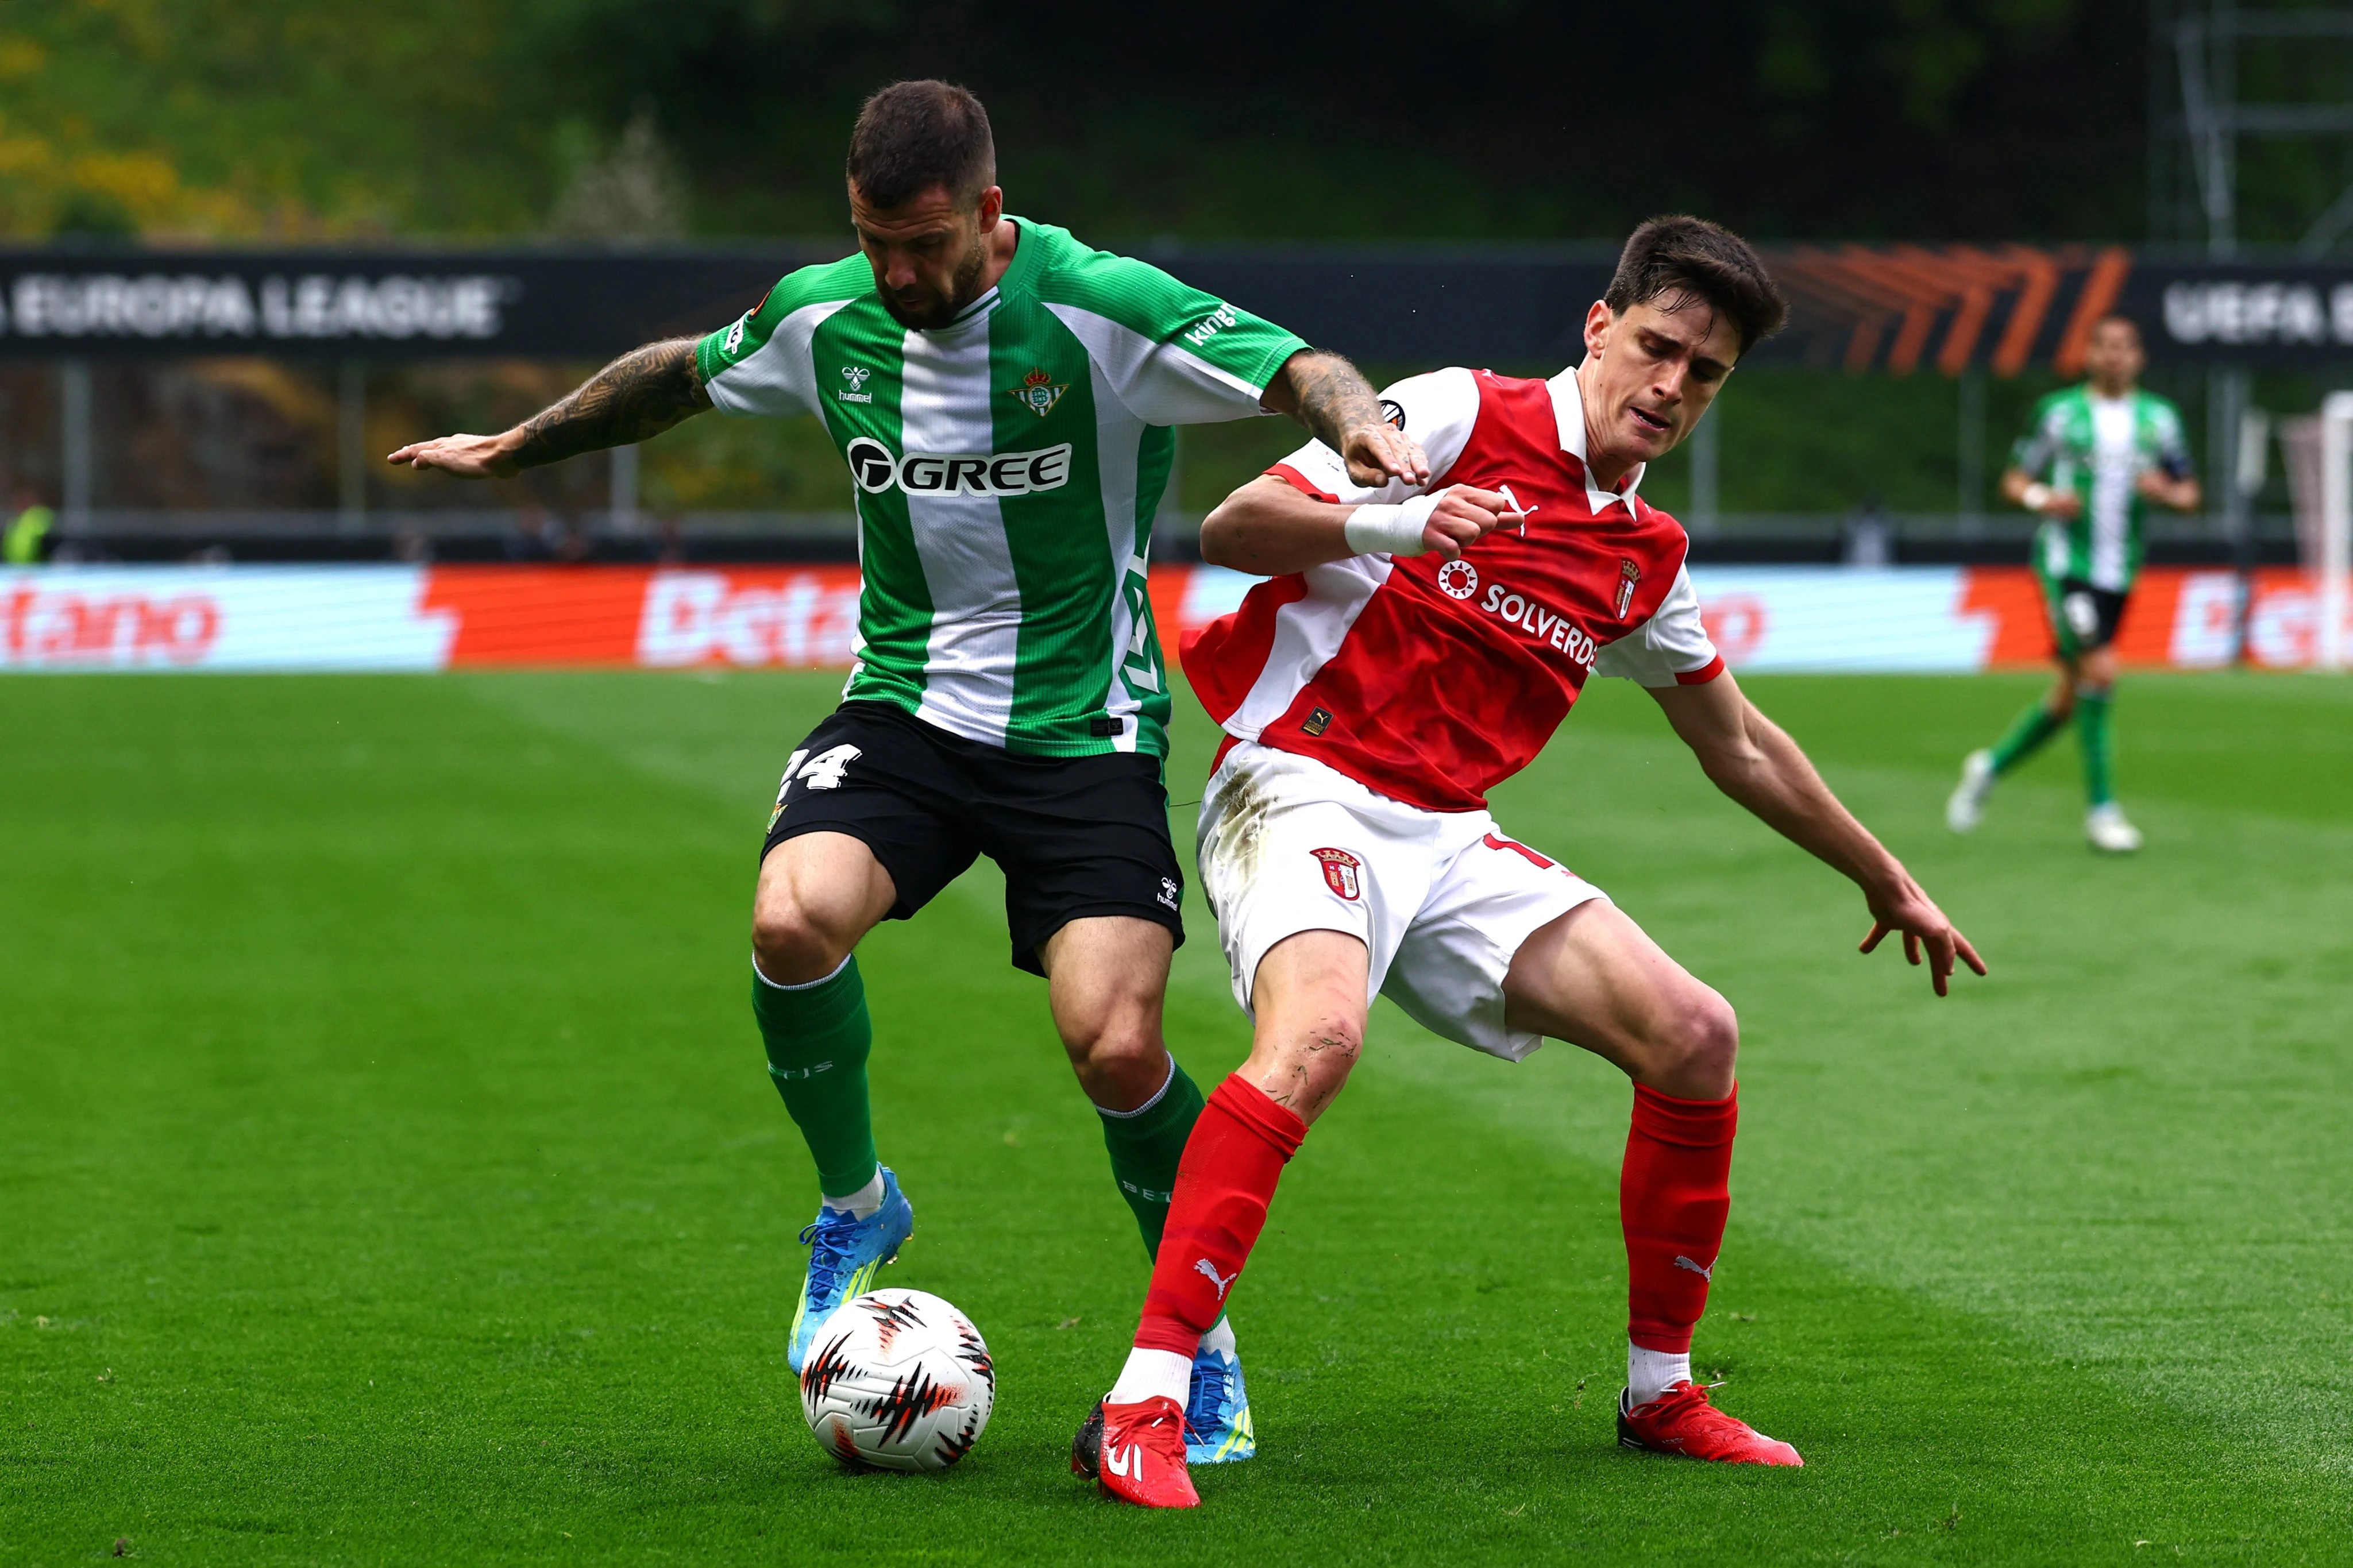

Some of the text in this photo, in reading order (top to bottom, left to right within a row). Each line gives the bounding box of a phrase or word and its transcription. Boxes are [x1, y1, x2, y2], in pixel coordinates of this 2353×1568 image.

[13, 273, 253, 338] EUROPA
[261, 273, 501, 338] LEAGUE
[2162, 281, 2324, 344] UEFA
[839, 389, 872, 404] hummel
[902, 448, 1067, 491] GREE
[1157, 892, 1178, 912] hummel
